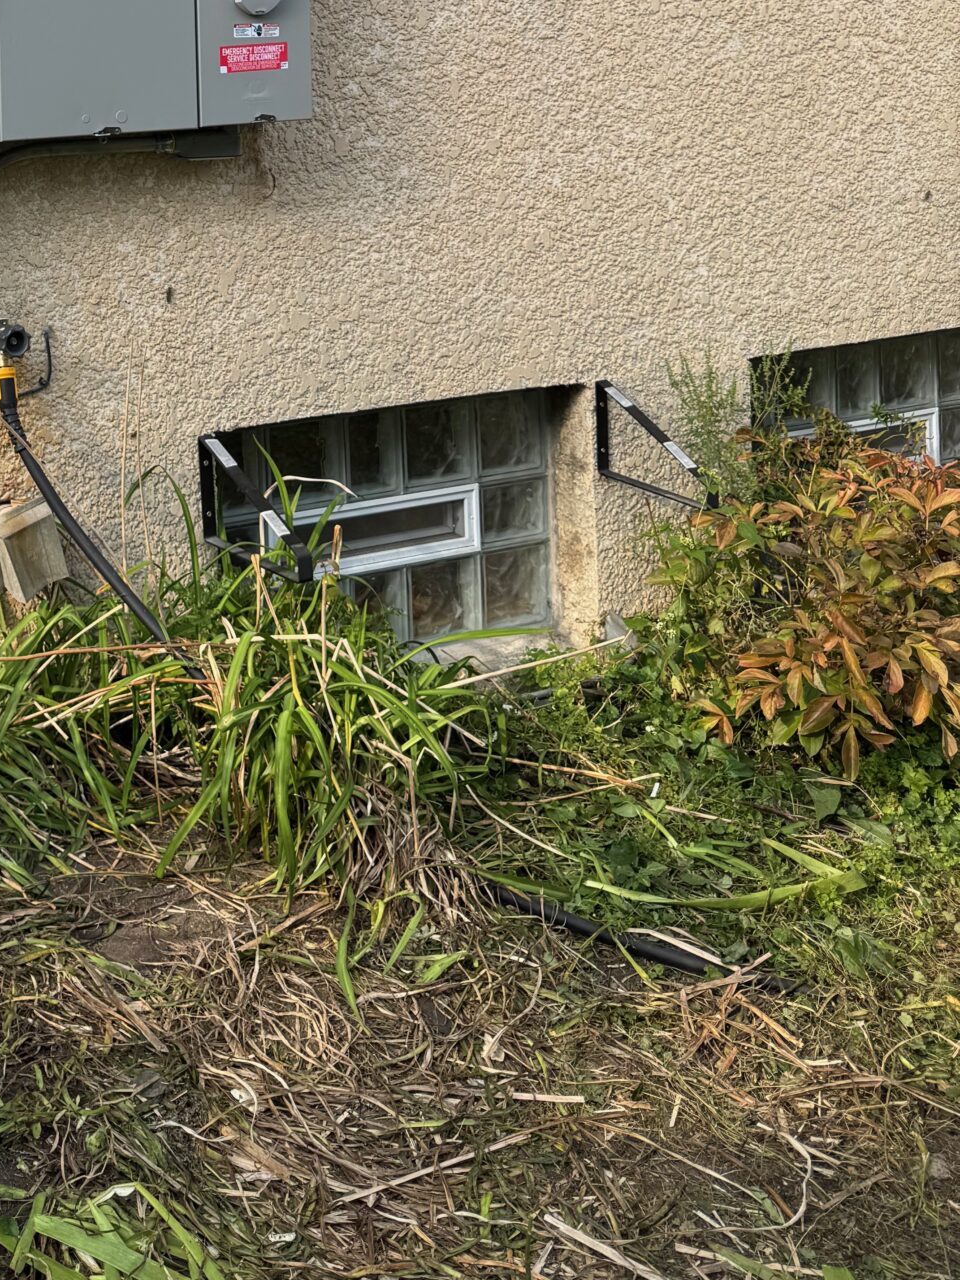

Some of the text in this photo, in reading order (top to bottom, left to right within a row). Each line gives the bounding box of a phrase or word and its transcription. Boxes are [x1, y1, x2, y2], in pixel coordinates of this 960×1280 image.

[222, 44, 284, 56] EMERGENCY DISCONNECT
[227, 52, 280, 63] SERVICE DISCONNECT
